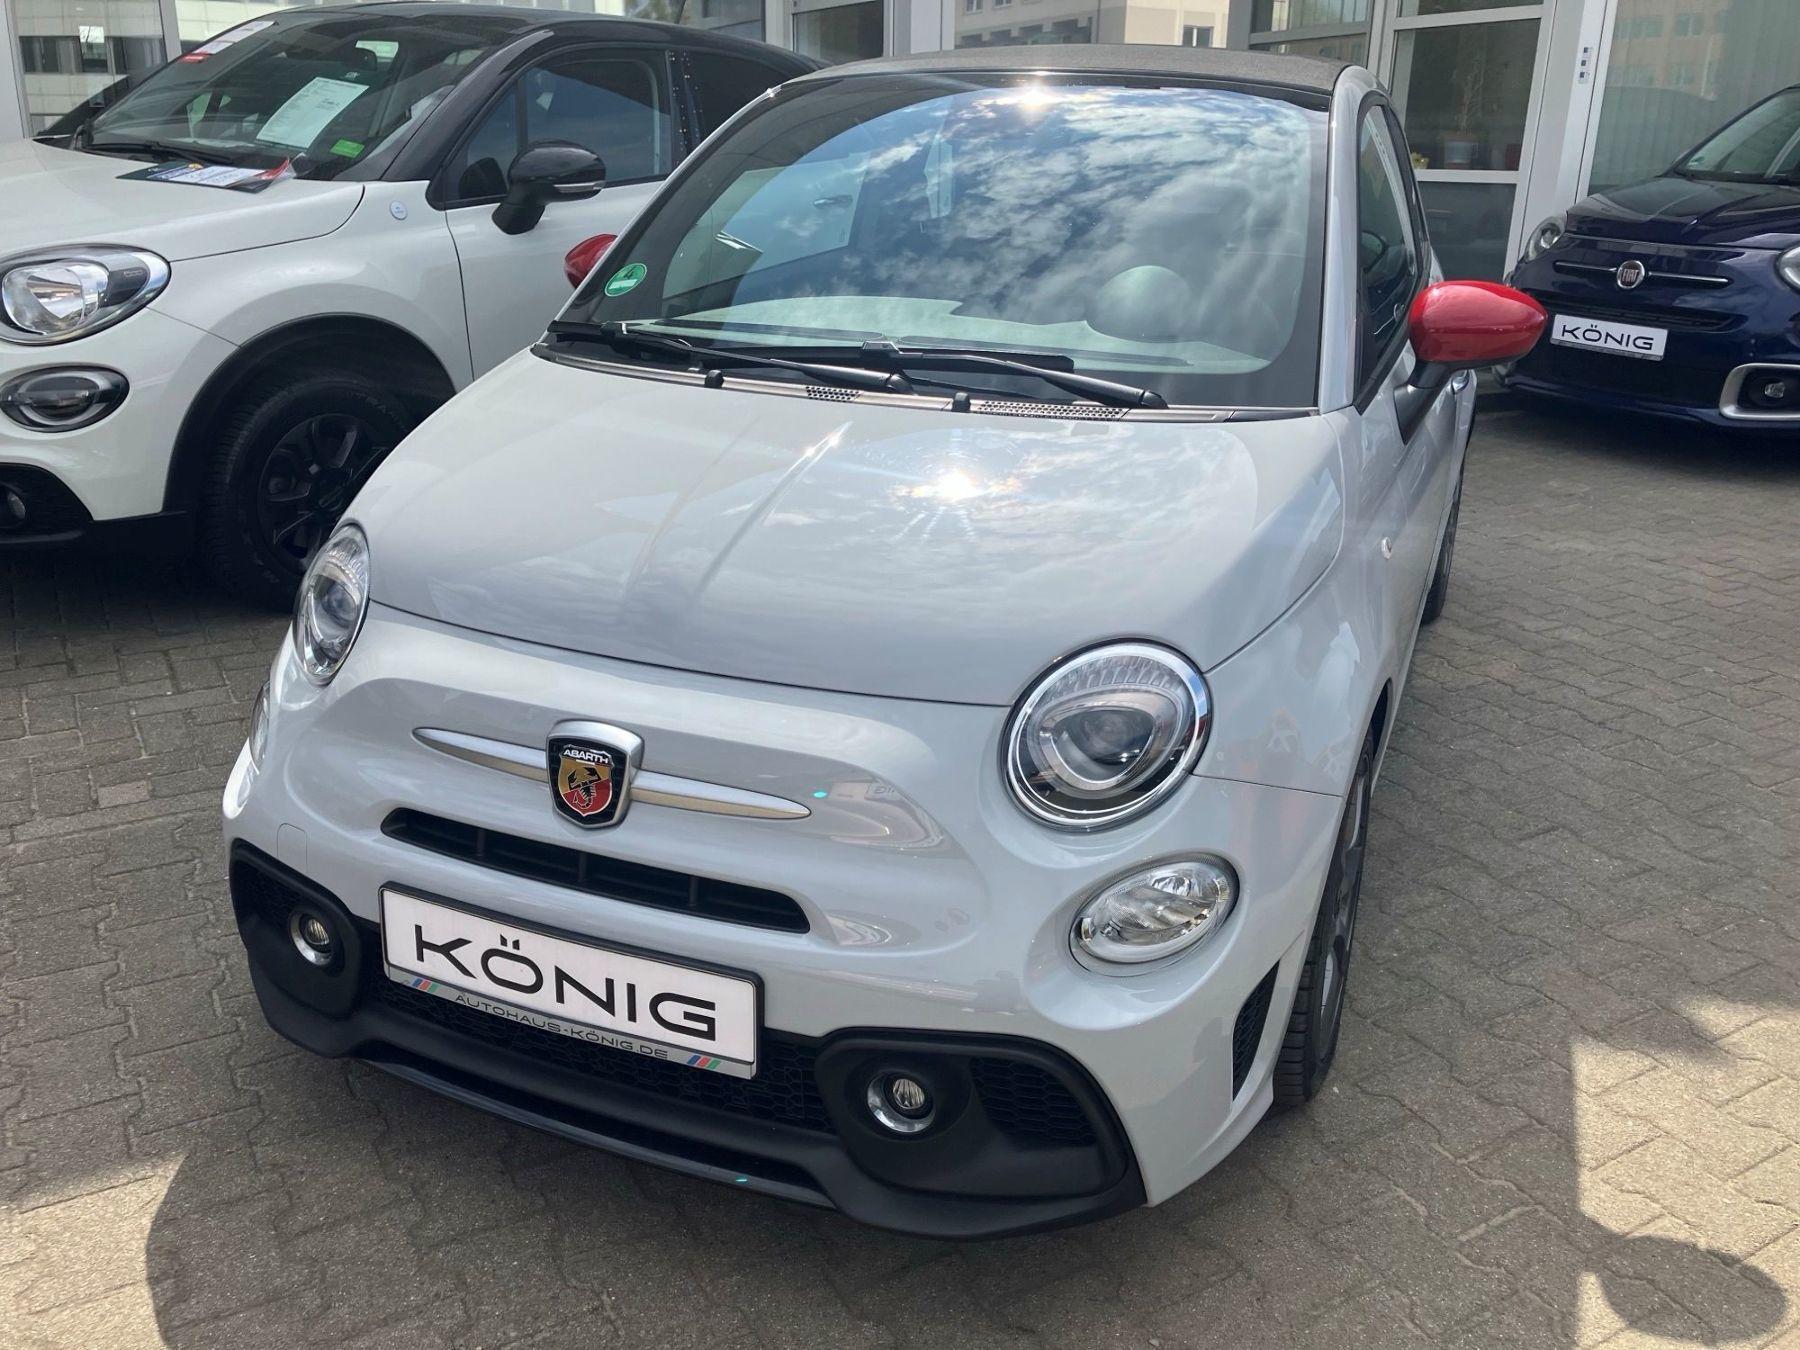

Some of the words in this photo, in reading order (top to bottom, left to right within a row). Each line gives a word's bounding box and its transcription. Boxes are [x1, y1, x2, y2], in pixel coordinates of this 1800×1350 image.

[1561, 323, 1655, 351] KÖNIG
[562, 748, 609, 765] ABARTH
[414, 924, 717, 1042] KÖNIG
[454, 993, 669, 1060] AUTOHAUS-KÖNIG.DE
